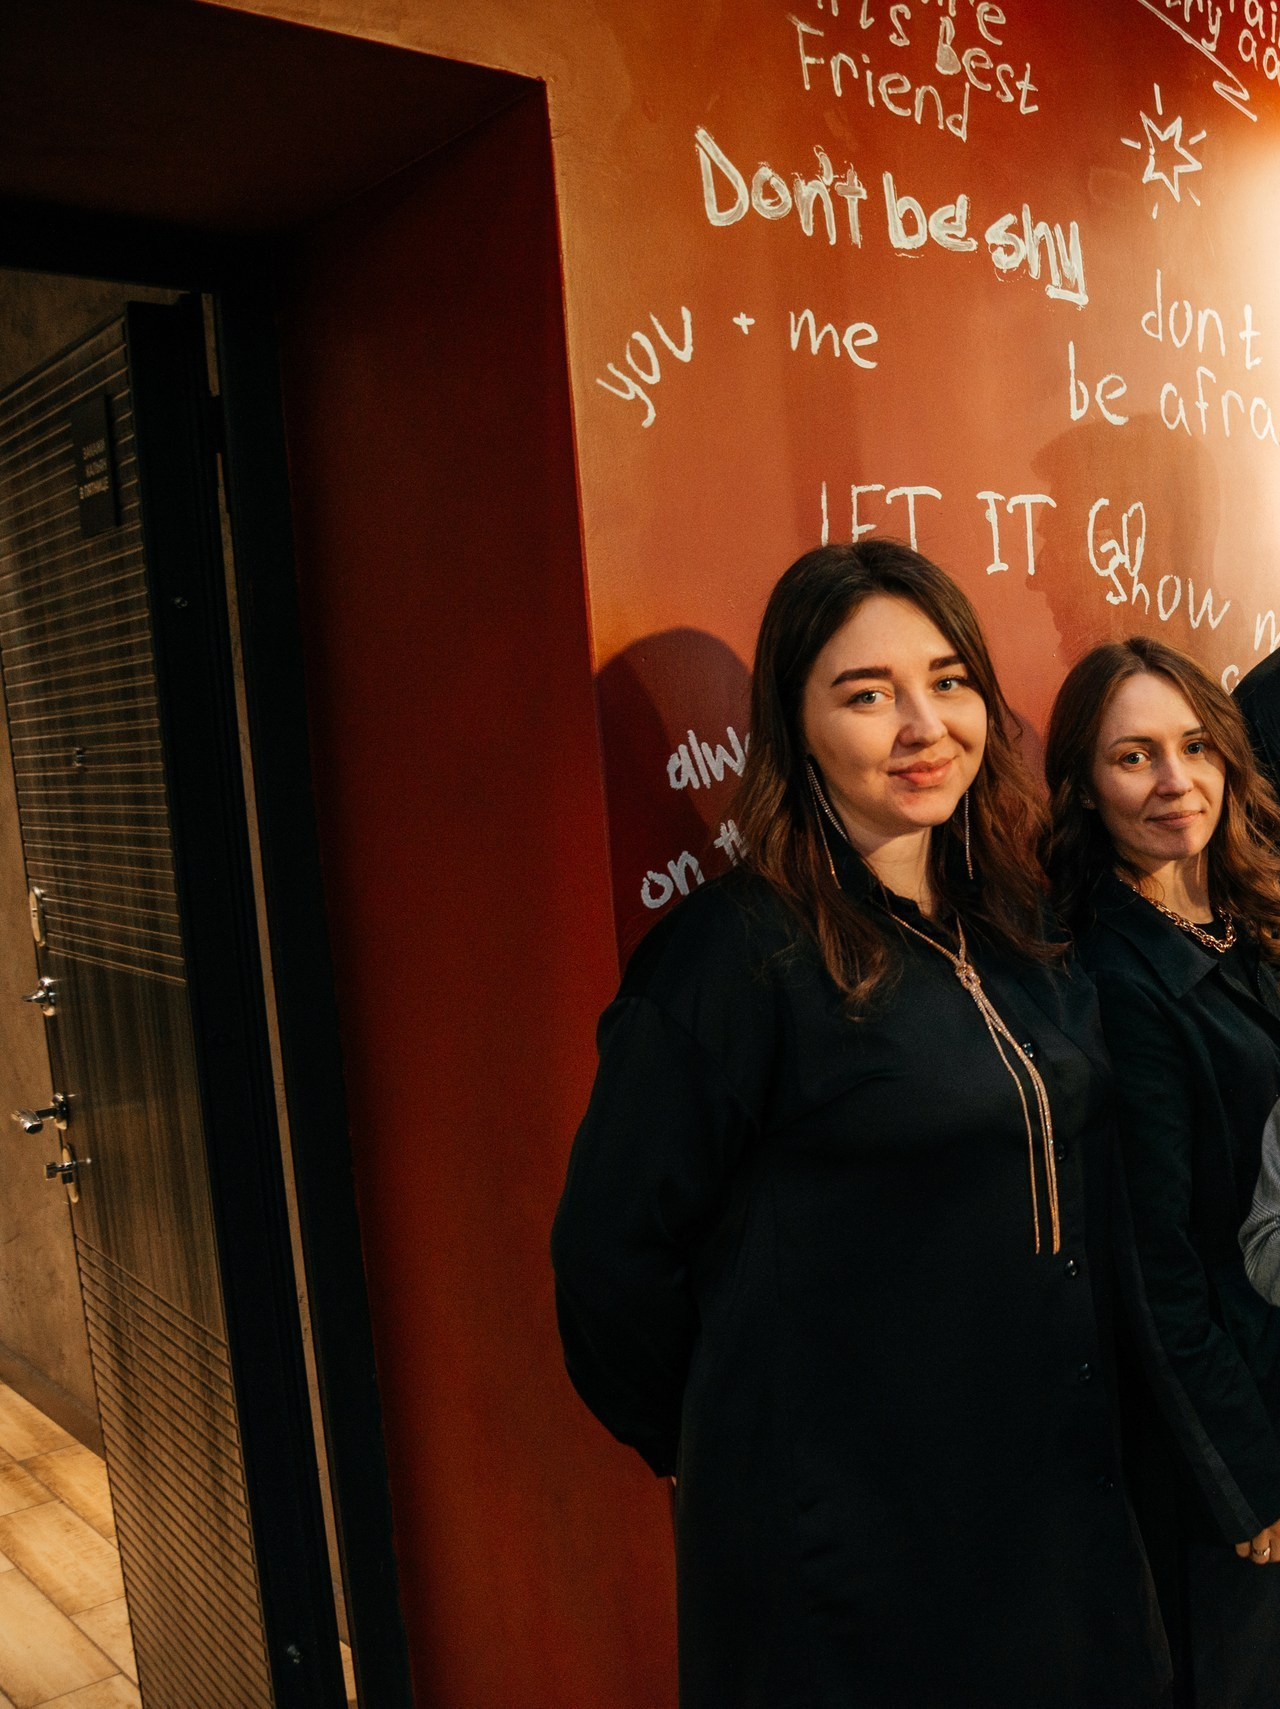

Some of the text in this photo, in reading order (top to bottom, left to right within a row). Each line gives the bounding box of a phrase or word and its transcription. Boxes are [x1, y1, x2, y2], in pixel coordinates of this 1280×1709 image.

[786, 13, 969, 143] Friend
[696, 126, 1089, 308] Don't be shy
[596, 306, 693, 428] you
[789, 309, 878, 369] me
[1068, 341, 1129, 426] be
[976, 490, 1057, 575] IT
[1088, 497, 1146, 577] GO
[641, 850, 705, 909] on
